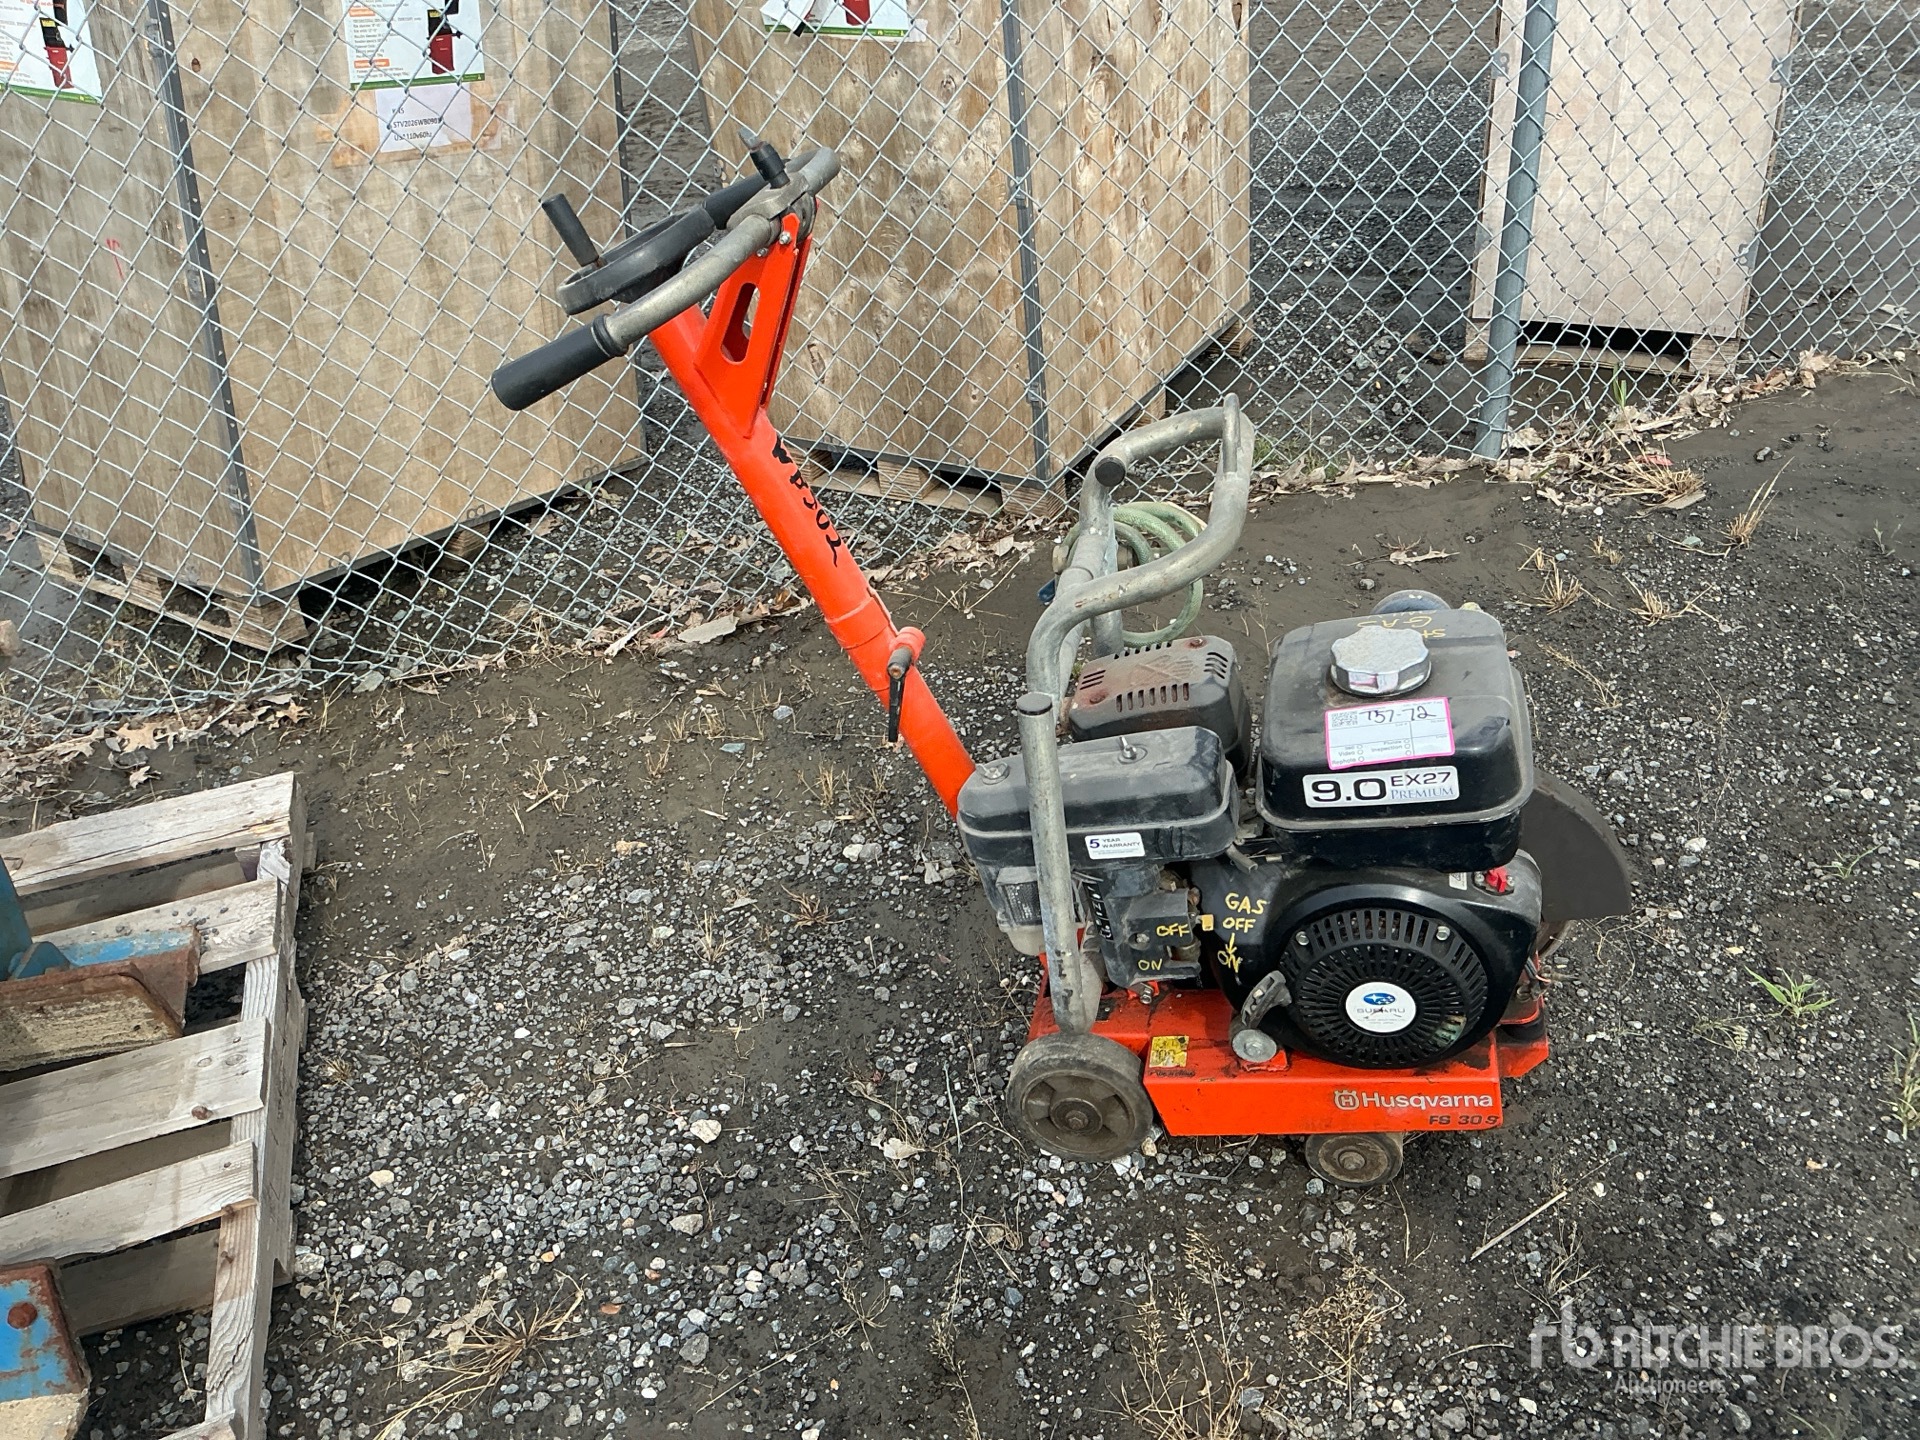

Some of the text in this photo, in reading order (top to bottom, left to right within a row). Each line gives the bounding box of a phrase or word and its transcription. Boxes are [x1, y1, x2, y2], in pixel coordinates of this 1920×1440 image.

[1311, 772, 1451, 802] 9.0 EX27
[1391, 786, 1454, 800] PREMIUM
[1089, 838, 1100, 849] 5
[1224, 892, 1268, 915] GAS
[1156, 923, 1190, 937] OFF
[1222, 917, 1256, 933] OFF
[1138, 959, 1163, 971] ON
[1217, 950, 1243, 973] ON
[1361, 1092, 1493, 1110] Husqvarna
[1428, 1115, 1500, 1125] FS 30 S
